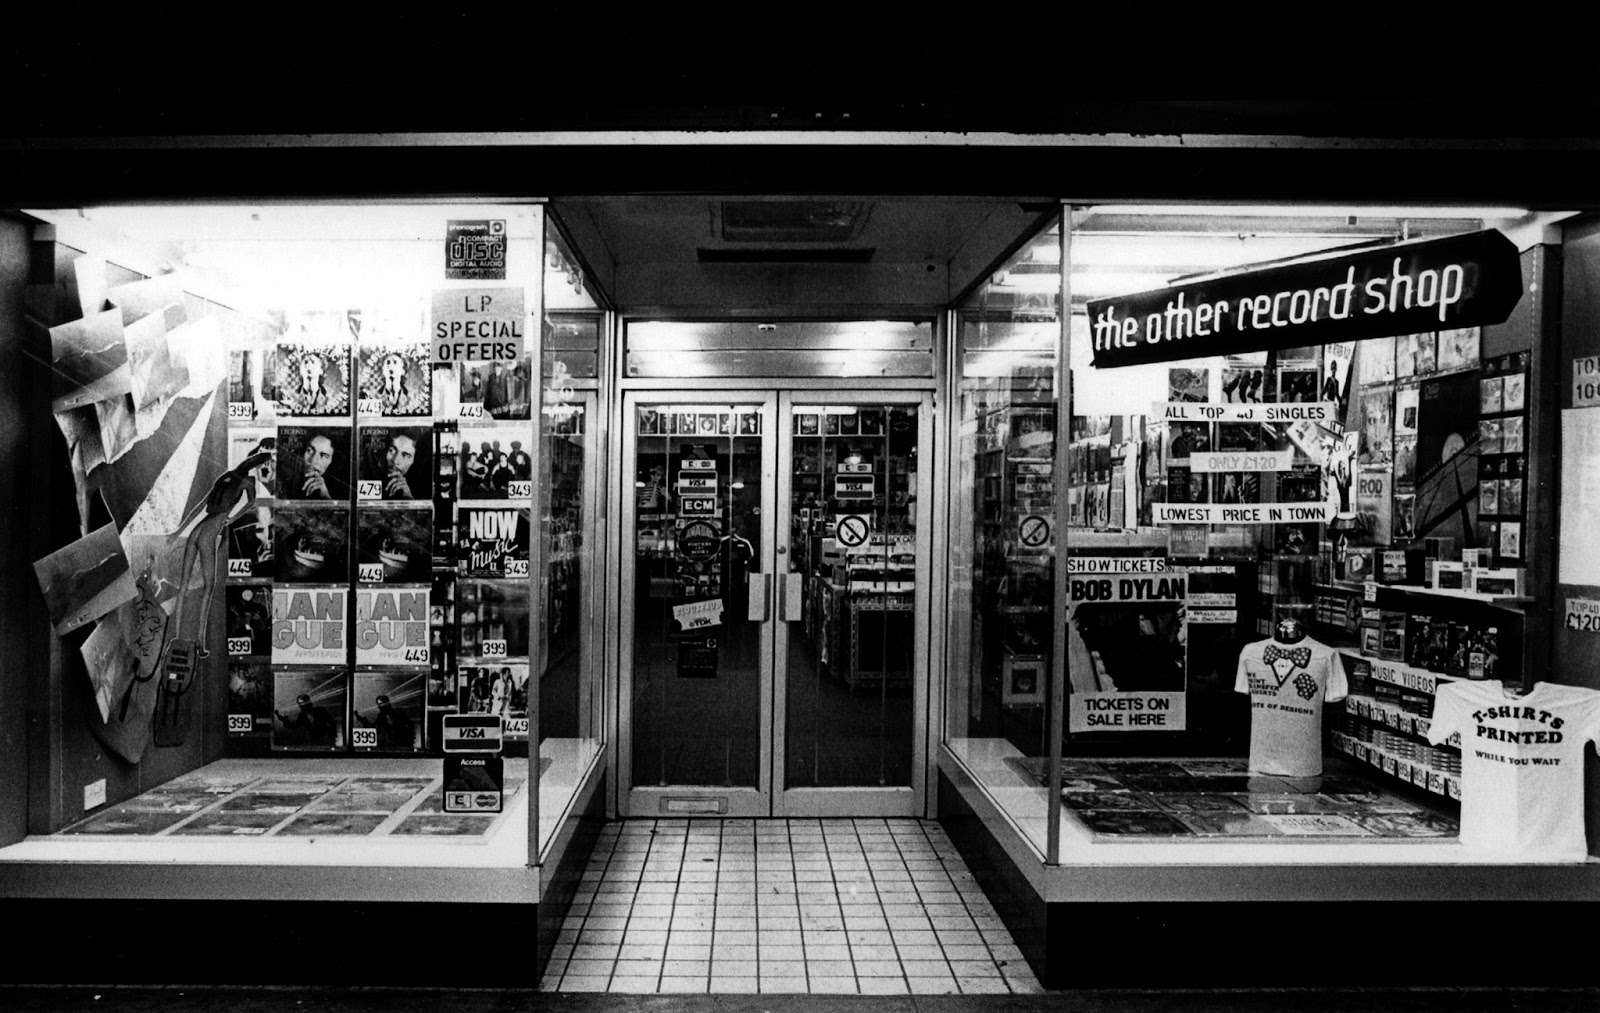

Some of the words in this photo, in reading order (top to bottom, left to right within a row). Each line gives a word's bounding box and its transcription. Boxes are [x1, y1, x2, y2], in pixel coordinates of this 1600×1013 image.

[1094, 305, 1139, 351] the
[1146, 291, 1229, 342] other
[1237, 265, 1356, 332] record
[1363, 256, 1464, 322] shop
[437, 320, 522, 338] SPECIAL
[438, 342, 517, 361] OFFERS
[229, 404, 252, 417] 399
[1165, 406, 1189, 419] ALL
[1198, 406, 1225, 419] TOP
[1266, 406, 1326, 420] SINGLES
[1208, 456, 1240, 470] ONLY
[359, 483, 382, 496] 479
[689, 479, 707, 487] VISA
[845, 483, 864, 491] VISA
[1360, 479, 1383, 495] ROD
[508, 484, 531, 497] 349
[684, 500, 713, 510] ECM
[1160, 507, 1211, 521] LOWEST
[1222, 508, 1261, 521] PRICE
[1269, 508, 1282, 521] IN
[1287, 507, 1326, 520] TOWN
[470, 511, 519, 539] NOW
[505, 562, 529, 575] 549
[1071, 580, 1113, 601] BOB
[1119, 578, 1185, 600] DYLAN
[272, 620, 343, 650] GUE
[356, 620, 427, 651] GUE
[228, 640, 250, 653] 399
[483, 642, 506, 655] 399
[1371, 665, 1396, 683] MUSIC
[1402, 672, 1434, 694] VIDEOS
[1084, 698, 1144, 711] TICKETS
[1147, 698, 1170, 711] ON
[1280, 705, 1314, 716] DESIGNS
[229, 716, 251, 730] 399
[1087, 713, 1124, 726] SALE
[1129, 713, 1166, 726] HERE
[1472, 705, 1565, 730] T-SHIRTS
[353, 731, 376, 744] 399
[460, 727, 485, 739] VISA
[1476, 725, 1563, 745] PRINTED
[460, 758, 486, 766] Access
[1475, 750, 1506, 763] WHILE
[1508, 757, 1529, 766] YOU
[1531, 757, 1561, 766] WAIT
